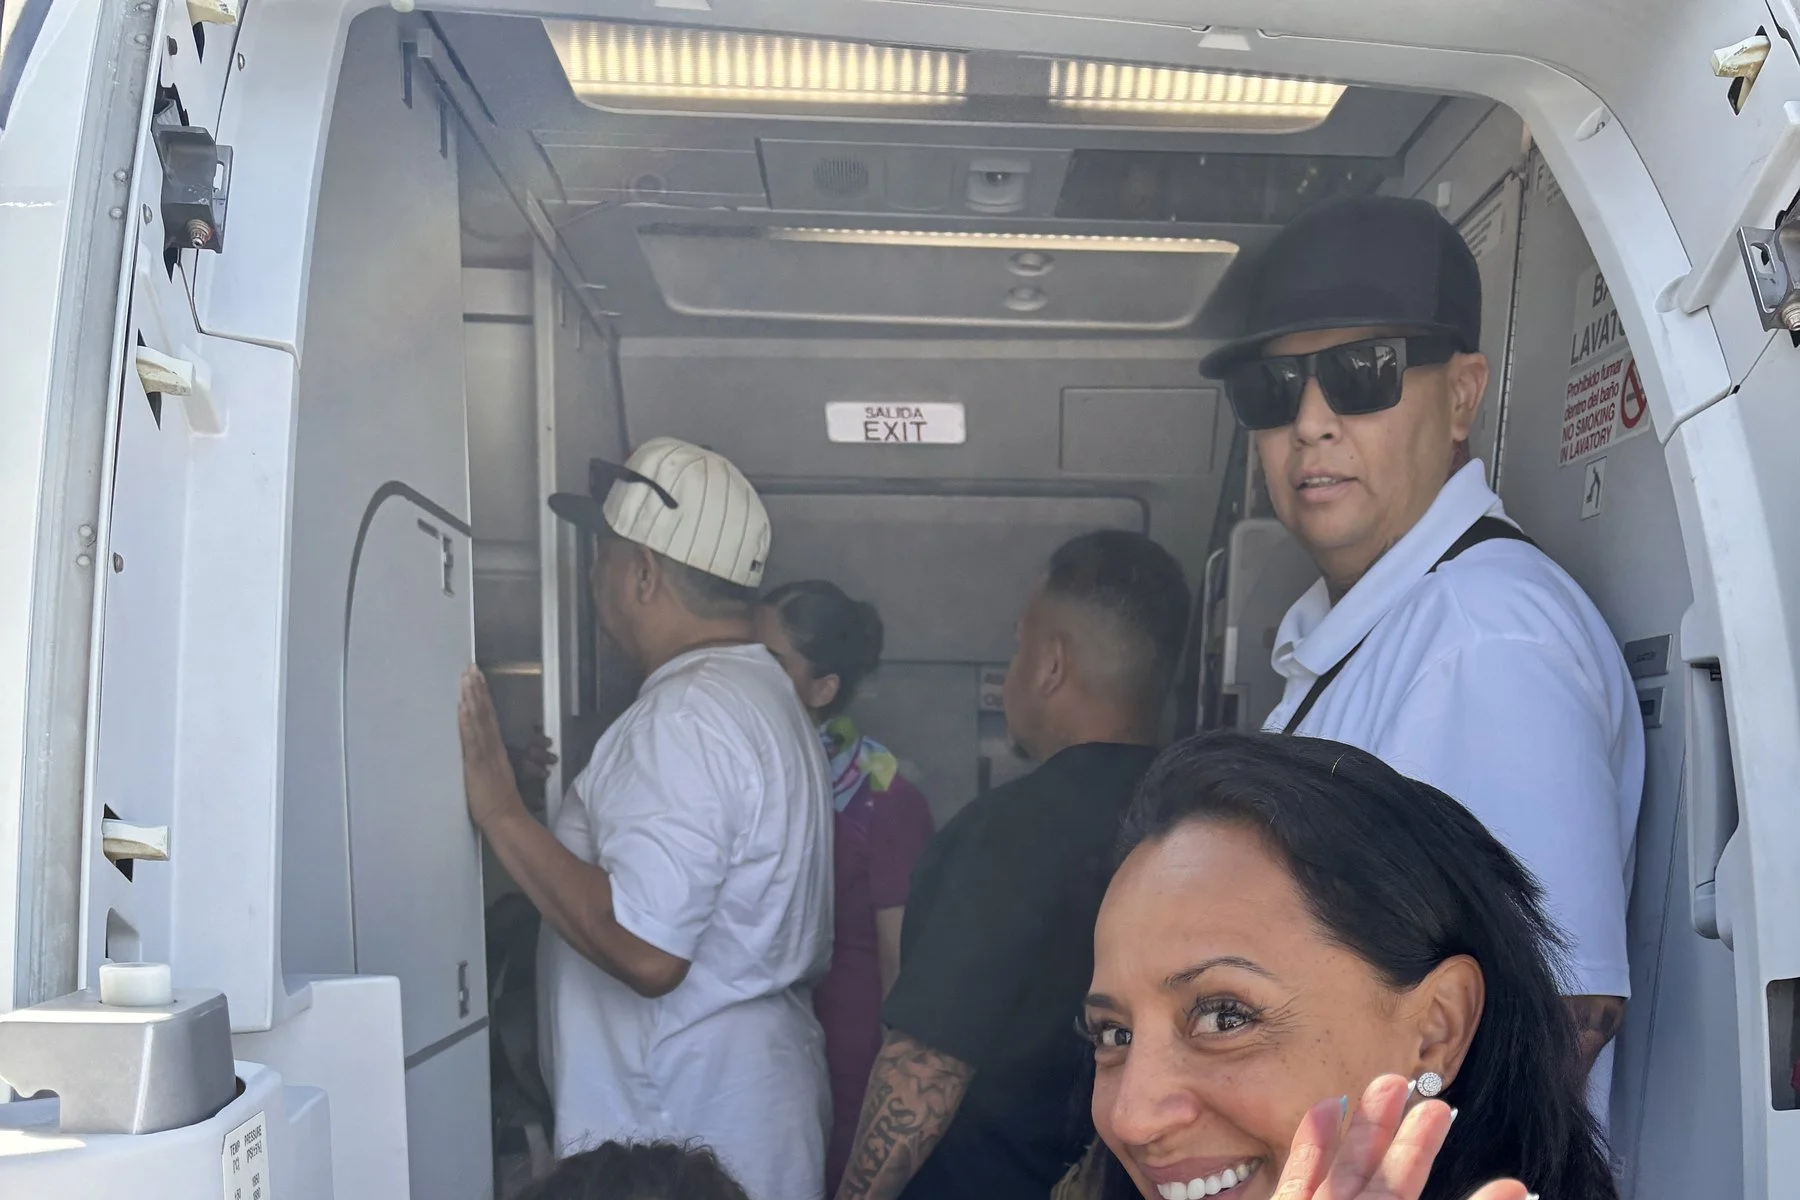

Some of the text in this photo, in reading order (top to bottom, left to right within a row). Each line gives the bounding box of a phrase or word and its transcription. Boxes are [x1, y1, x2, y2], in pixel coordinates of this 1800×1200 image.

[1567, 359, 1624, 400] Prohibido fumar
[864, 406, 924, 419] SALIDA
[1564, 381, 1620, 422] dentro del baño
[864, 421, 928, 441] EXIT
[1562, 402, 1615, 444] NO SMOKING
[1560, 425, 1613, 463] IN LAVATORY
[244, 1124, 262, 1147] PRESSURE
